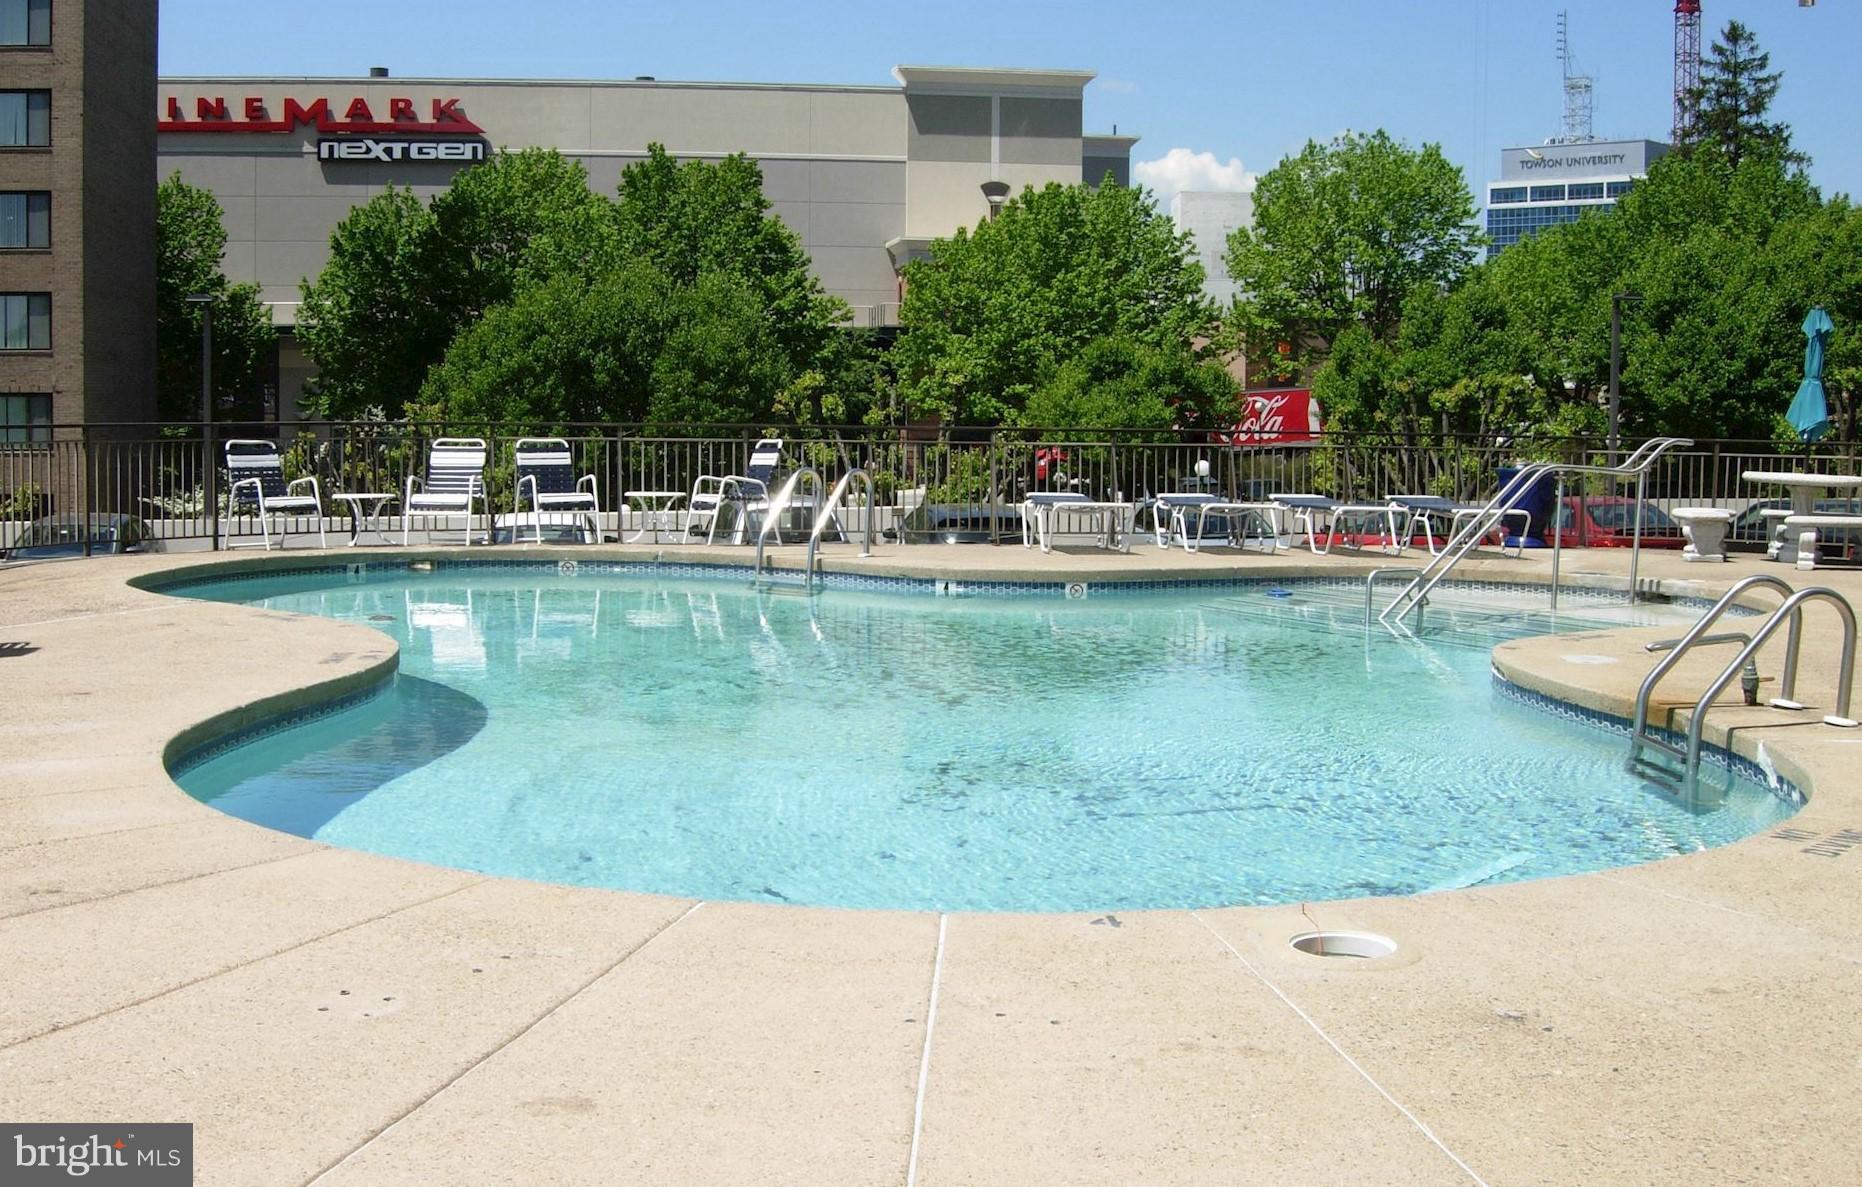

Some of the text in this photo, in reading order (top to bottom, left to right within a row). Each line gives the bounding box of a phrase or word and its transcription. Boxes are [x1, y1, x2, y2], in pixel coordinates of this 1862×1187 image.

[158, 97, 486, 133] INEMARK
[1520, 154, 1625, 170] TOWSON UNIVERSITY
